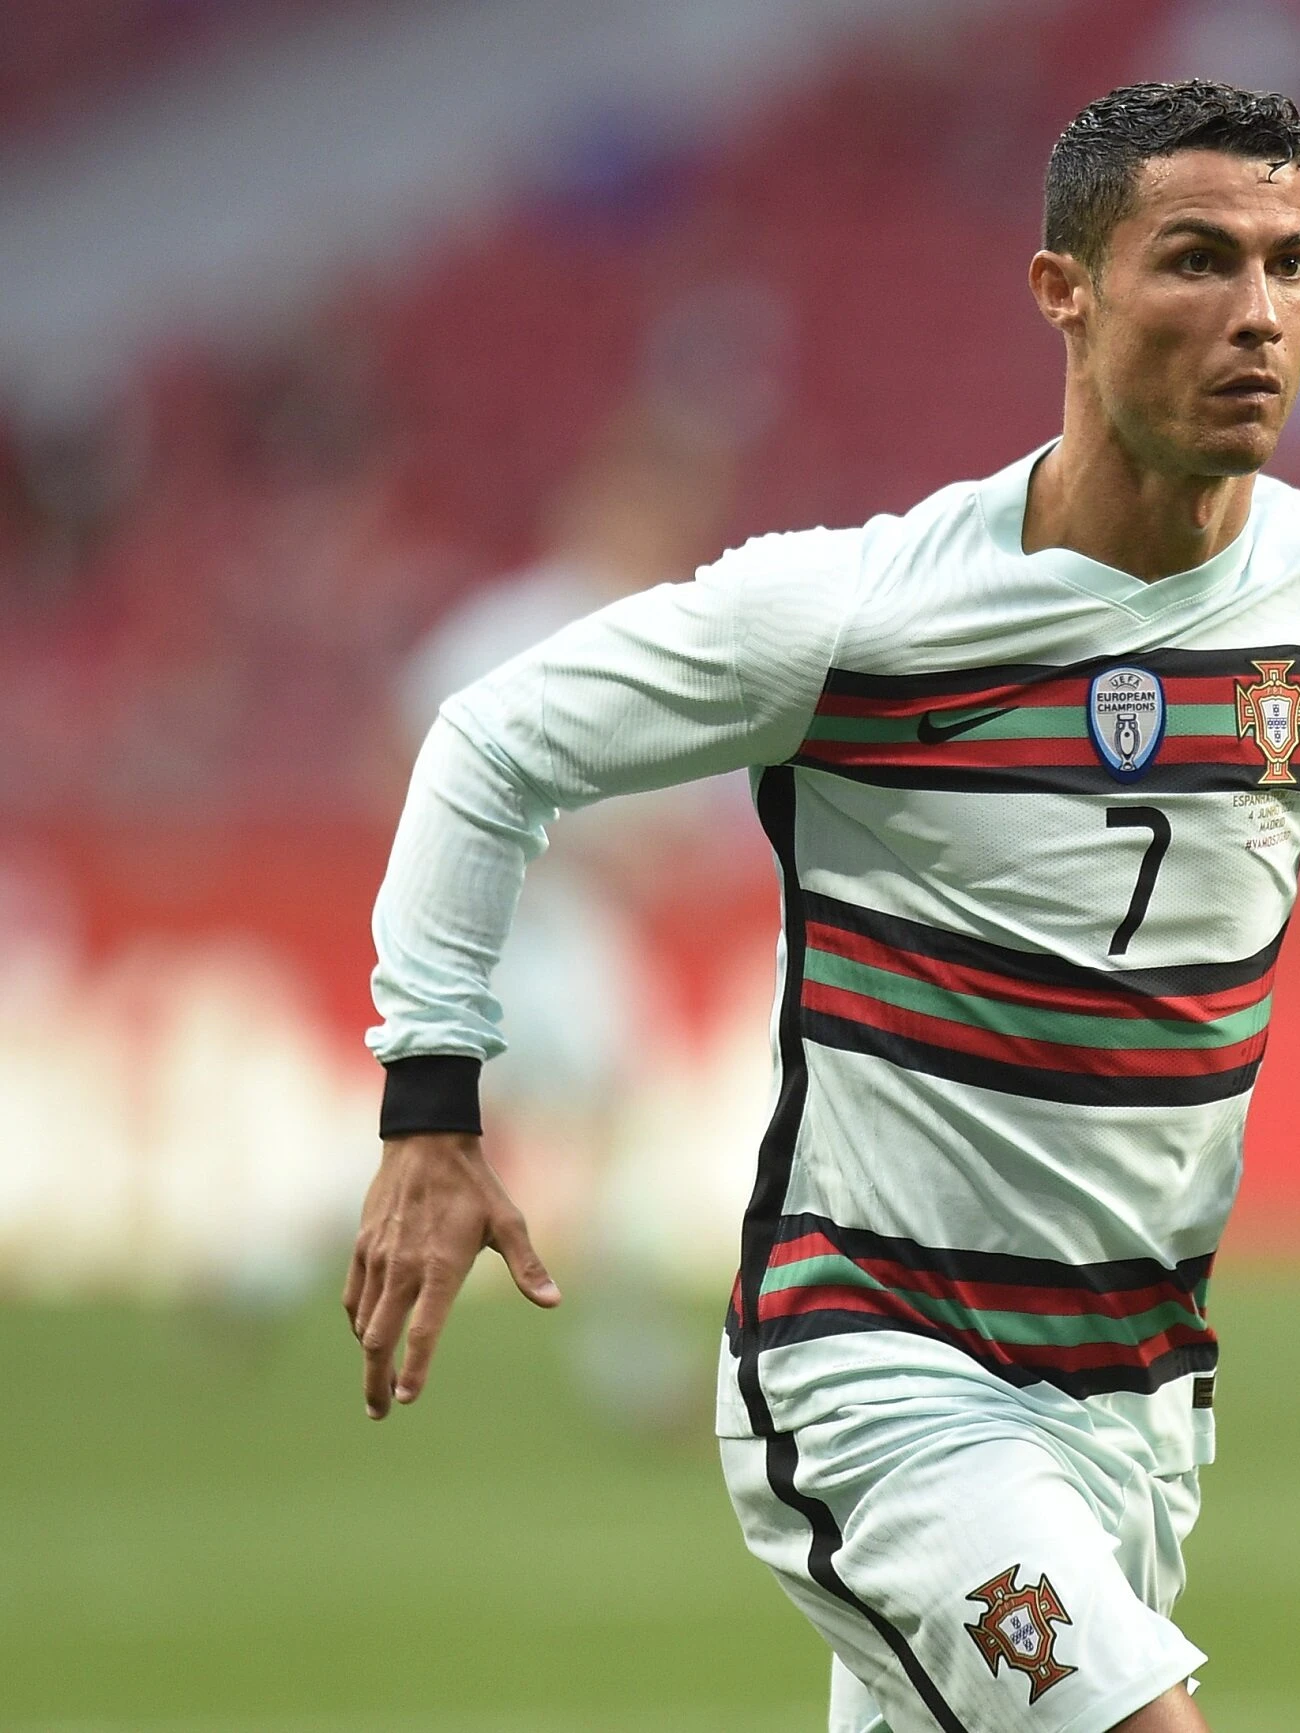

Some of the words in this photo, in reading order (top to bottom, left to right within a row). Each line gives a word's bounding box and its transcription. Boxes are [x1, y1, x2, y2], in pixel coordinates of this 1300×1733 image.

[1110, 675, 1140, 688] UEFA
[1097, 692, 1156, 702] EUROPEAN
[1097, 703, 1156, 712] CHAMPIONS
[1248, 810, 1254, 819] 4
[1259, 817, 1285, 831] MADRID
[1106, 806, 1172, 956] 7
